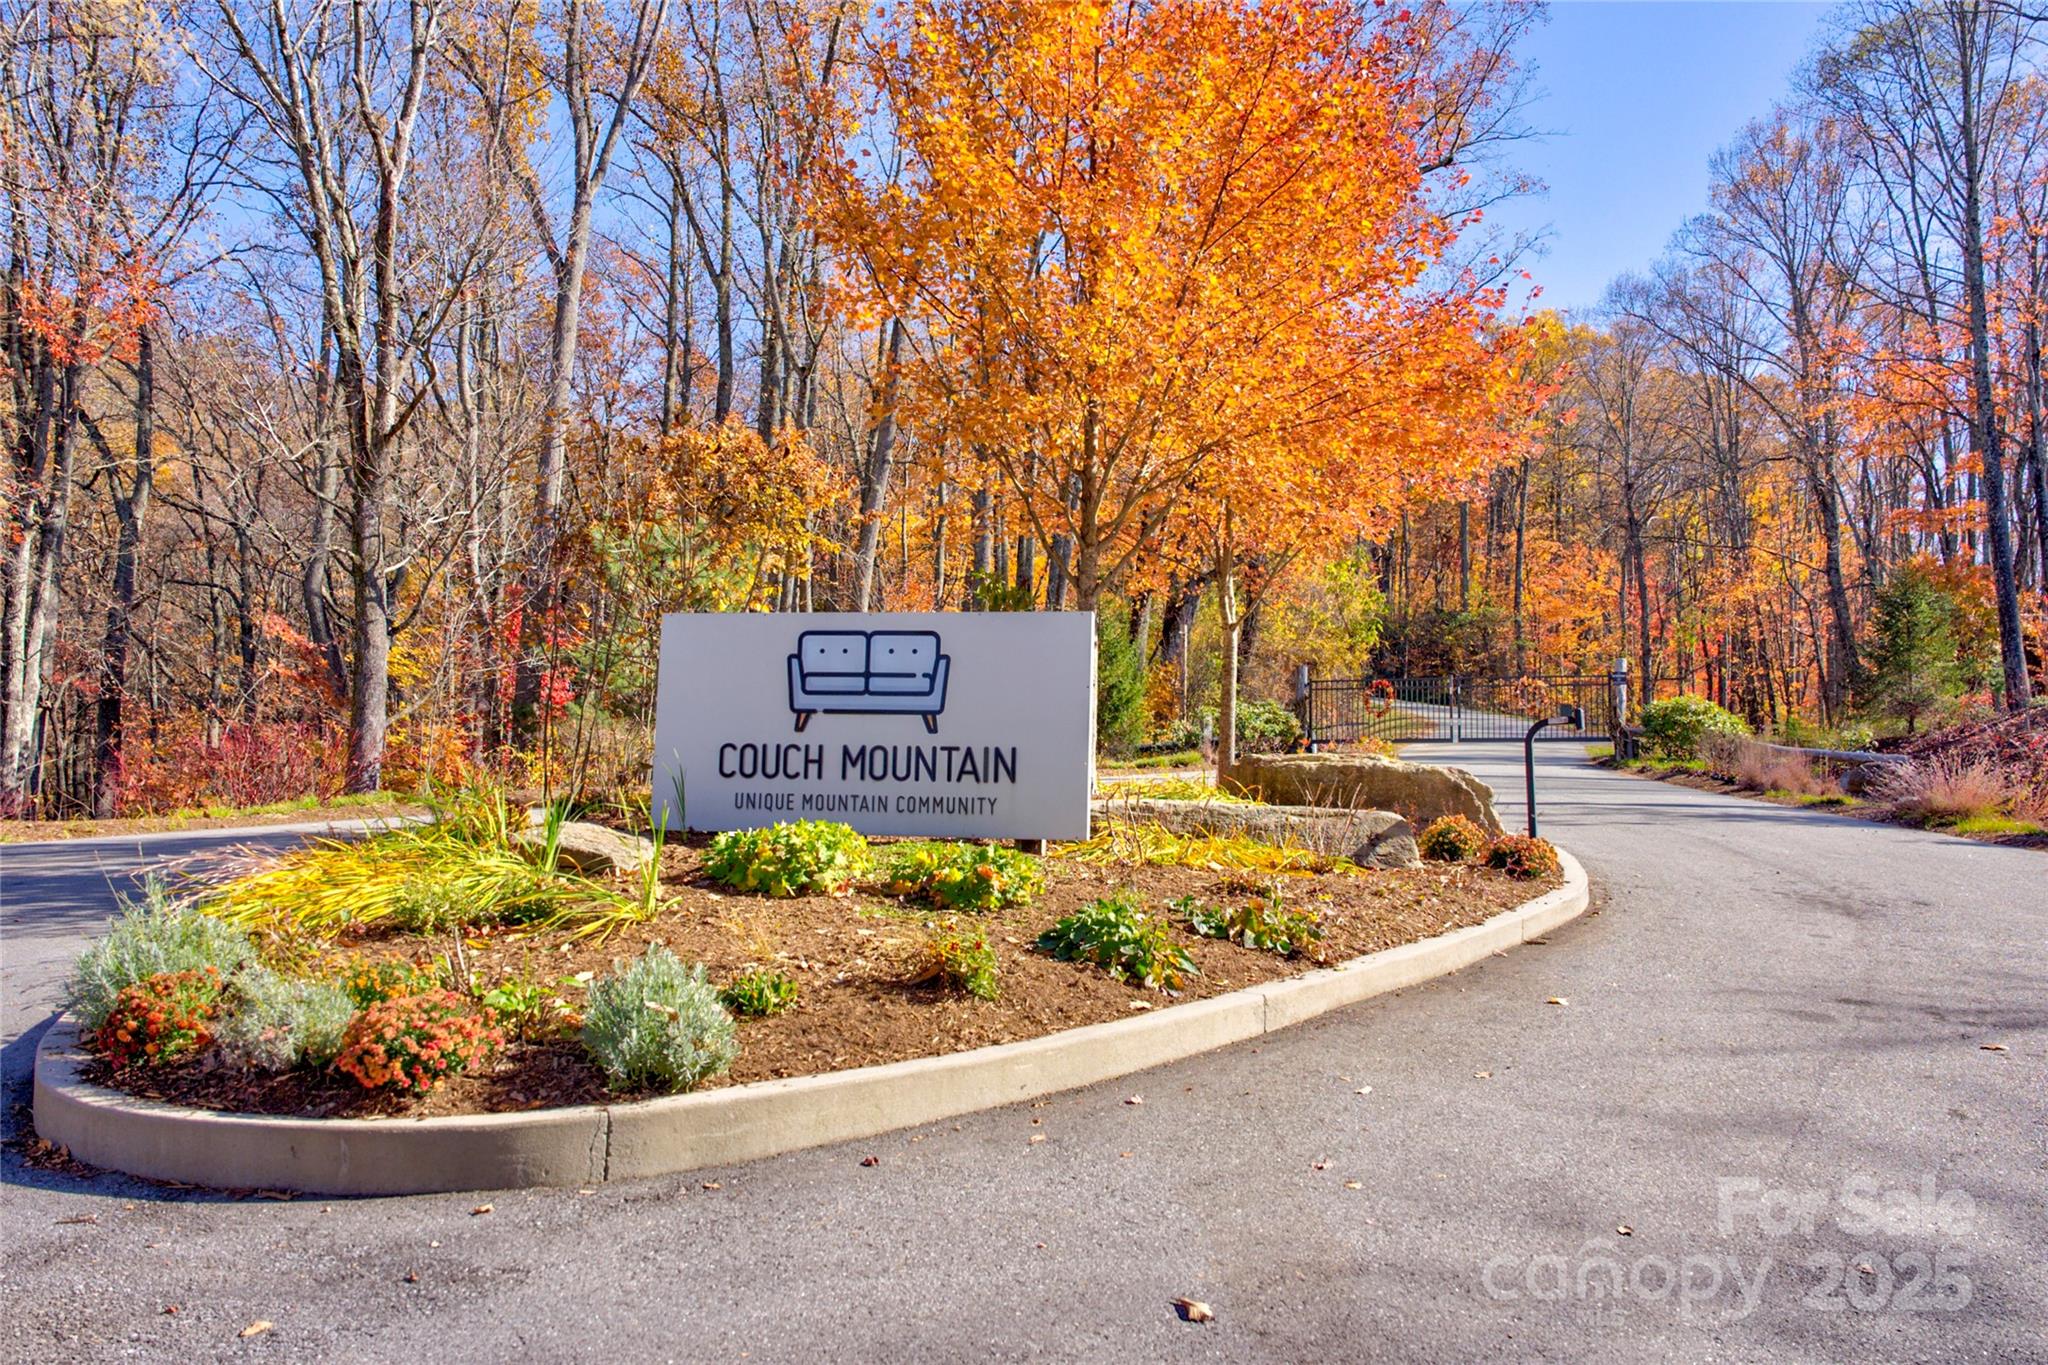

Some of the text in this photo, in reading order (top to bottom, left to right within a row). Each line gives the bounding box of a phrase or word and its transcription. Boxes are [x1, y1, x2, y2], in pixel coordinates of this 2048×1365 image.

[718, 742, 1018, 785] COUCH MOUNTAIN
[734, 791, 998, 816] UNIQUE MOUNTAIN COMMUNITY
